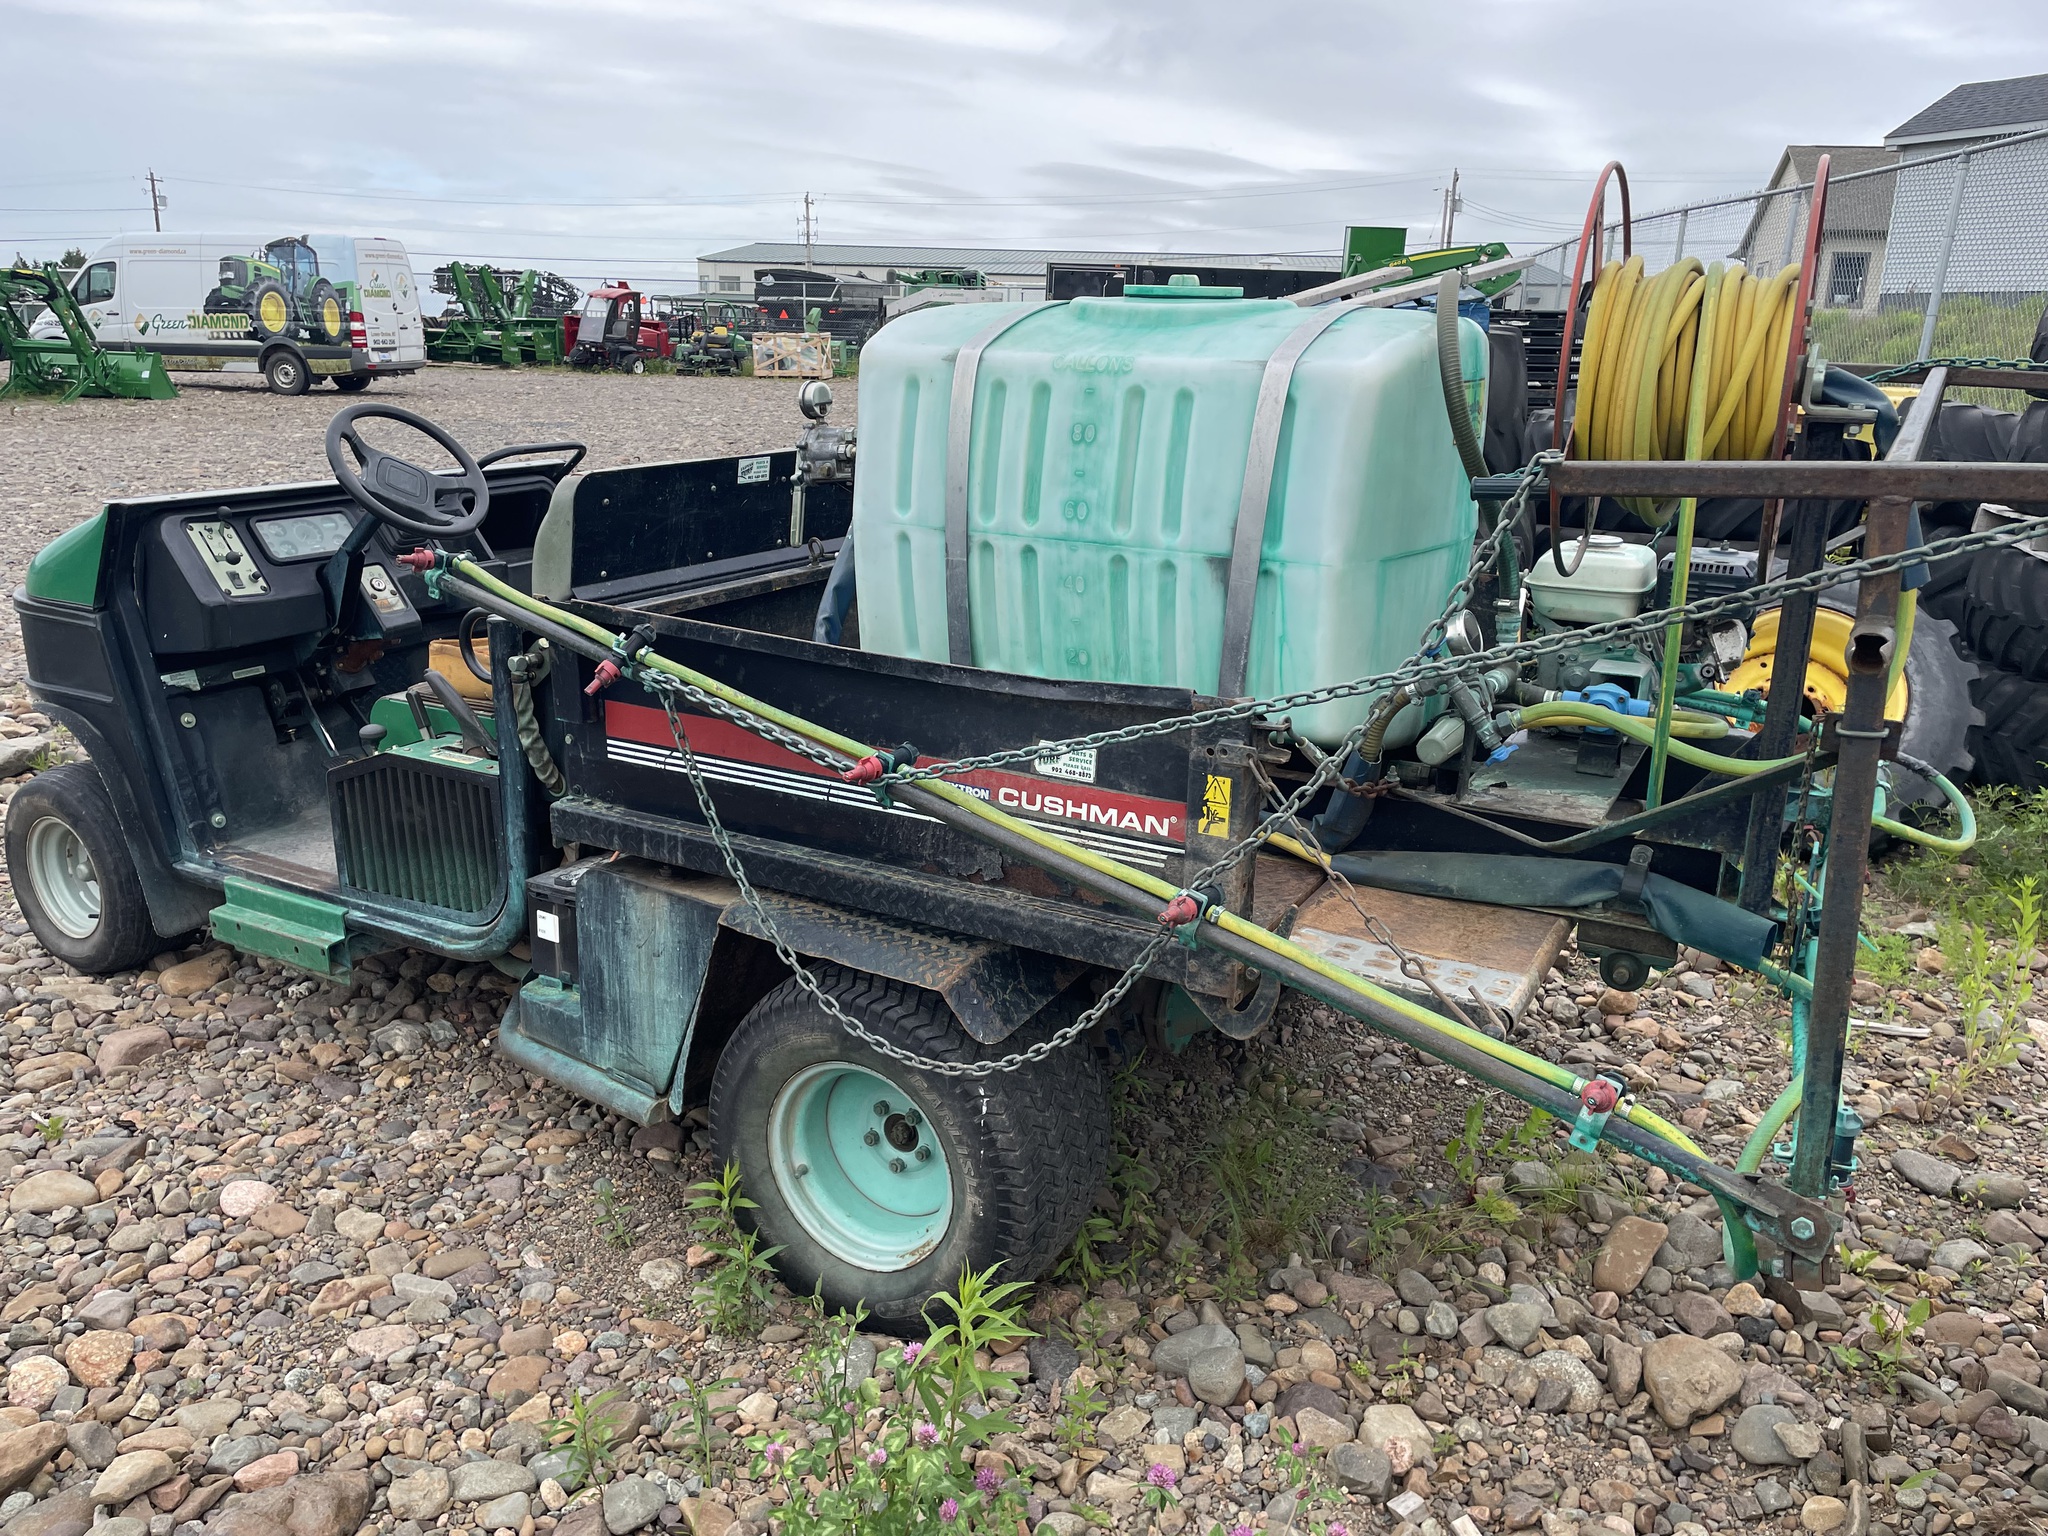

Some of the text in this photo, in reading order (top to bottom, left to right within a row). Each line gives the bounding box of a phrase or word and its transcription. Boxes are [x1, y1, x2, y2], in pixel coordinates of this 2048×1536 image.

[152, 313, 249, 336] Green DIAMOND
[1071, 423, 1097, 444] 80
[1064, 501, 1088, 520] 60
[1064, 575, 1085, 593] 40
[1066, 648, 1089, 666] 20
[1068, 756, 1093, 765] SERVICE
